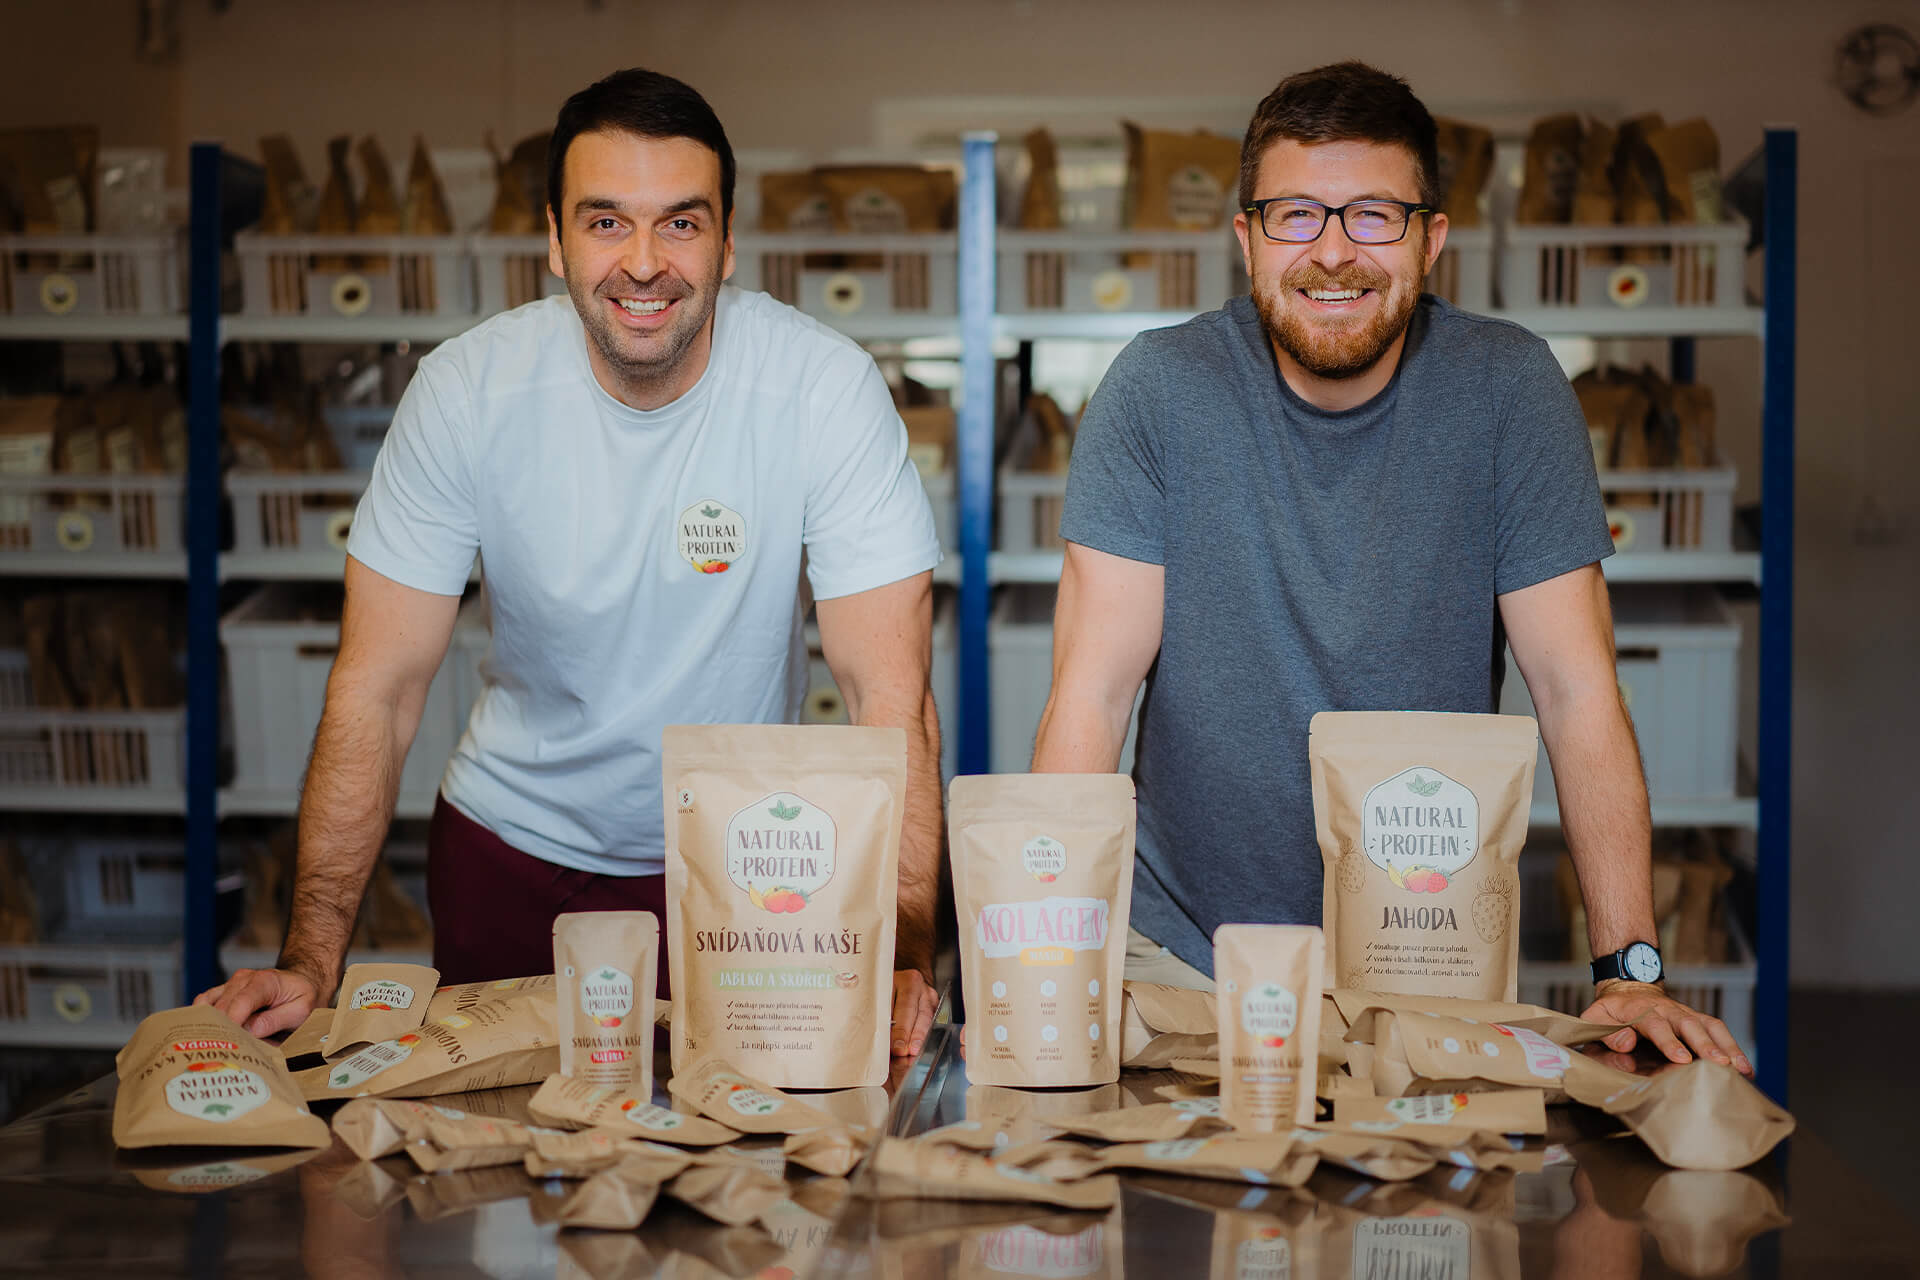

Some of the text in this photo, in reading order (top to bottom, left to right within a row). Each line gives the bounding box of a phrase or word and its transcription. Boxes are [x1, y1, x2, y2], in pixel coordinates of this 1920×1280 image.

[683, 523, 738, 538] NATURAL
[687, 541, 736, 555] PROTEIN
[1375, 806, 1469, 828] NATURAL
[738, 830, 824, 851] NATURAL
[1381, 833, 1460, 857] PROTEIN
[1026, 849, 1062, 858] NATURAL
[743, 856, 817, 878] PROTEIN
[981, 906, 1104, 944] KOLAGEN
[1380, 906, 1458, 931] JAHODA
[696, 926, 863, 955] SNÍDAŇOVÁ KAŠE
[719, 972, 763, 987] JABLKO
[767, 972, 776, 987] A
[585, 985, 630, 997] NATURAL
[588, 998, 627, 1010] PROTEIN
[178, 1041, 234, 1050] JAHODA
[180, 1074, 250, 1089] PROTEIN
[180, 1085, 259, 1101] NATURAL
